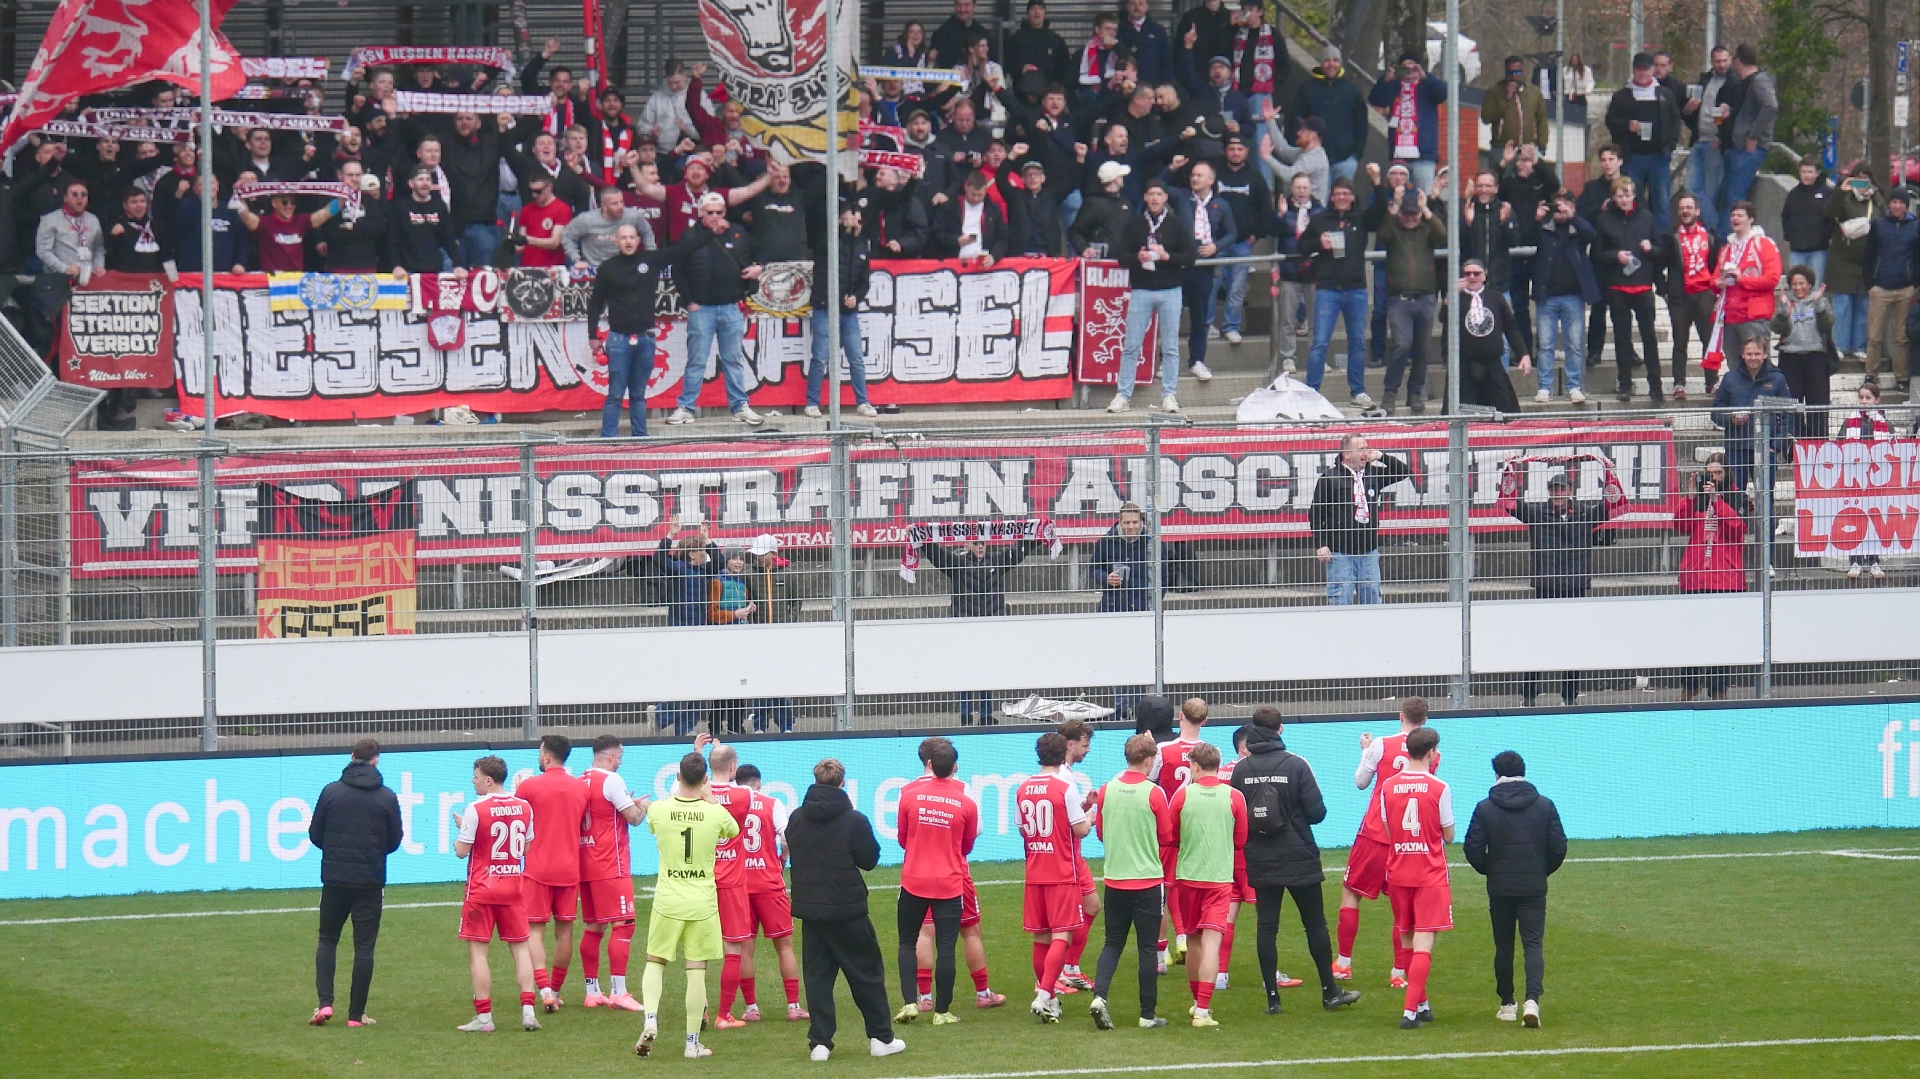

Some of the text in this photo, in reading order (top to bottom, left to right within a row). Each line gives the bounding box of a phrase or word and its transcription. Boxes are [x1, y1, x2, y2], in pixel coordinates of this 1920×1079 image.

[389, 47, 442, 60] HESSEN
[71, 294, 156, 314] SEKTION
[70, 314, 159, 334] STADION
[74, 334, 157, 353] VERBOT
[174, 285, 583, 398] HESSEN
[1795, 441, 1920, 492] VORST
[89, 459, 1030, 549] VERNDSSTRAFEN
[910, 520, 1035, 543] KSV HESSEN KASSEL
[258, 538, 415, 591] HESSEN
[1877, 719, 1919, 799] fi
[1271, 775, 1288, 785] KASSEL
[1393, 782, 1429, 795] KNIPPING
[1025, 785, 1048, 795] STARK
[489, 804, 524, 818] PODOLSKI
[926, 795, 945, 804] HESSEN
[945, 797, 962, 808] KASSEL
[670, 810, 704, 822] WEYAND
[918, 815, 949, 826] bergische
[926, 808, 954, 819] württem
[1020, 799, 1053, 838] 30
[1401, 797, 1422, 837] 4
[490, 819, 527, 860] 26
[680, 826, 694, 865] 1
[1394, 842, 1430, 853] POLYMA
[488, 864, 521, 875] POLYM
[667, 869, 706, 879] POLYMA
